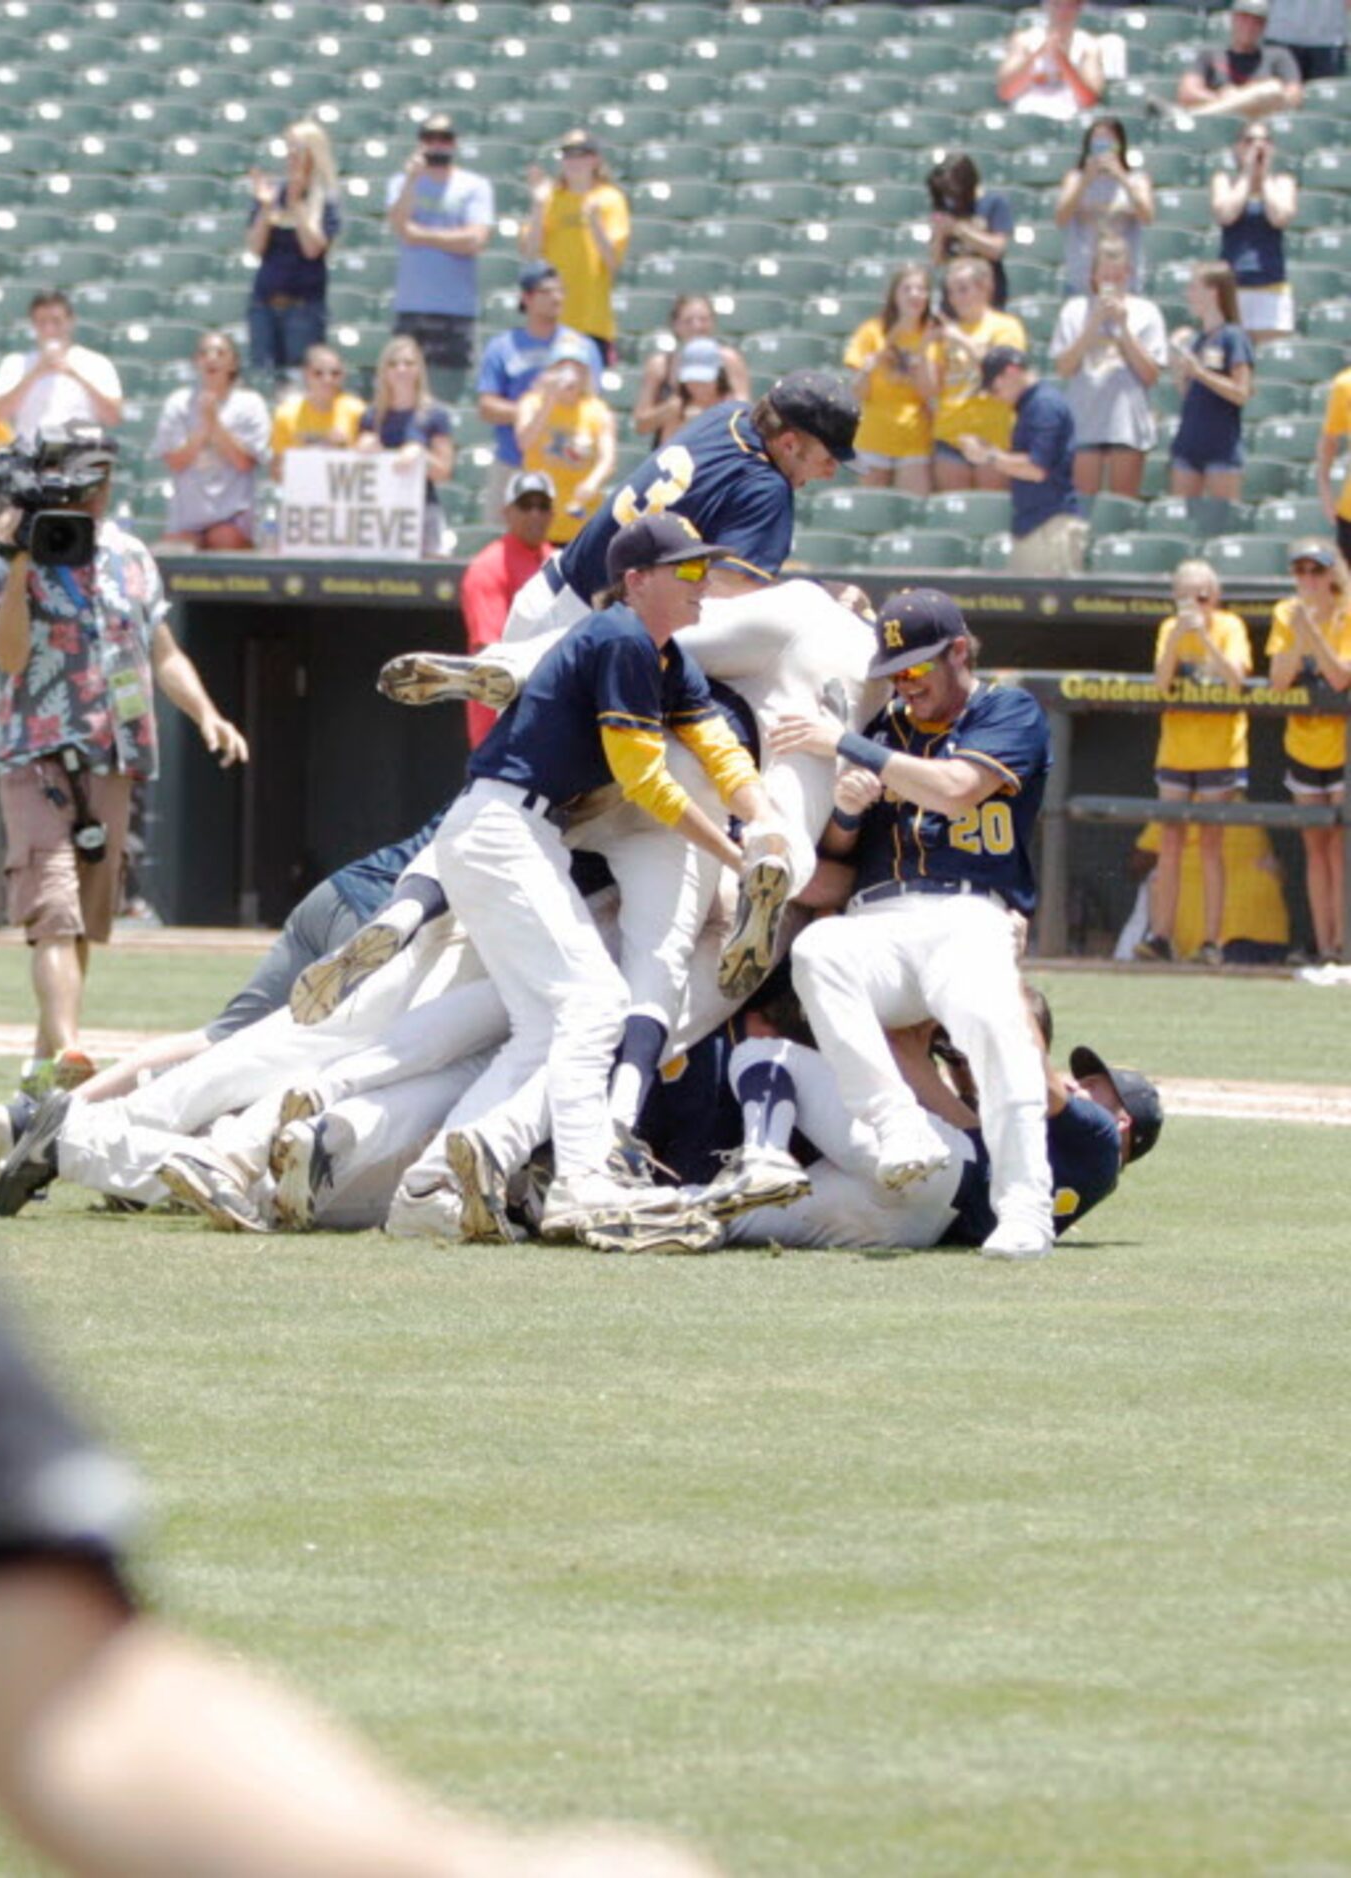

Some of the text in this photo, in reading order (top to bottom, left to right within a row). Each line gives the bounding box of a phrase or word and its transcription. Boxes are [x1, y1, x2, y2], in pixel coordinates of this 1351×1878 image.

[327, 460, 377, 502] WE
[285, 505, 418, 548] BELIEVE
[950, 801, 1014, 855] 20
